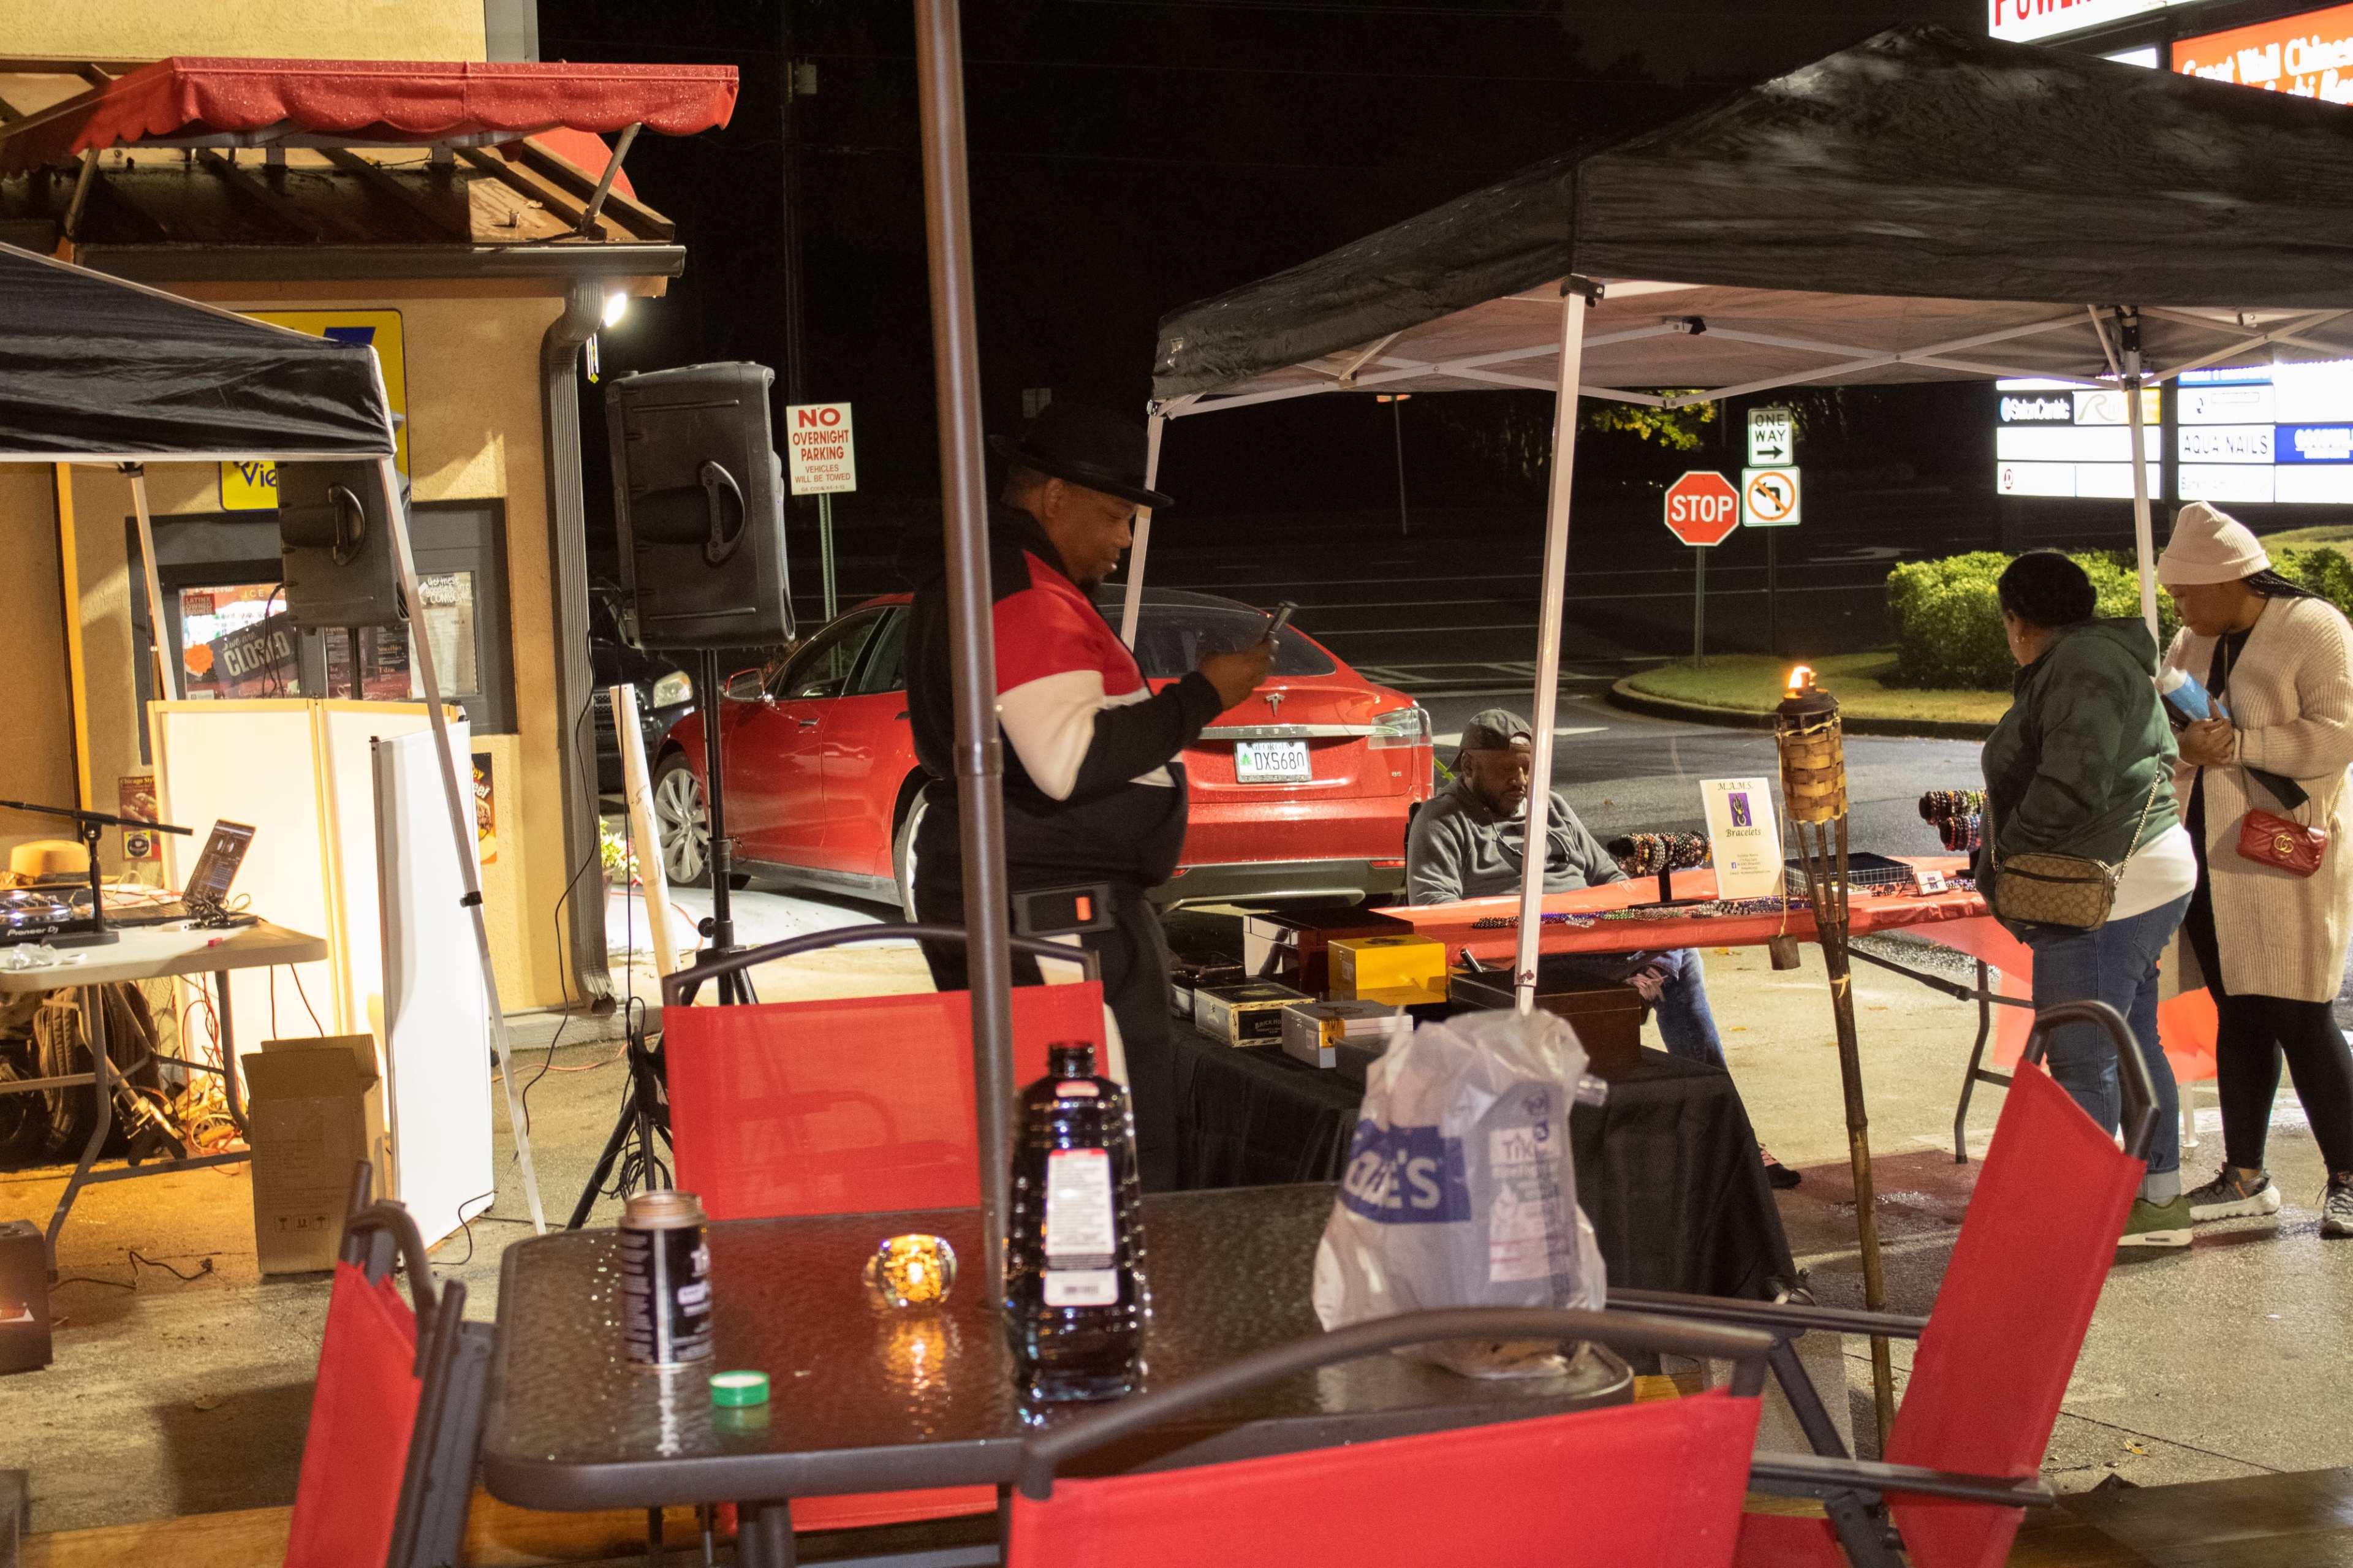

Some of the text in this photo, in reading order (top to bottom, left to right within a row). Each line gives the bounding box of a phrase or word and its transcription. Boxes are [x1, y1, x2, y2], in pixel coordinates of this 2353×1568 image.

[798, 407, 841, 428] NO
[1755, 414, 1785, 426] ONE
[793, 430, 849, 445] OVERNIGHT
[1755, 430, 1786, 442] WAY
[2184, 434, 2267, 454] AQUA NAILS
[801, 446, 844, 461] PARKING
[805, 464, 839, 473] VEHICLES
[826, 472, 851, 482] TOWED
[1671, 494, 1733, 522] STOP
[1725, 828, 1762, 838] Bracelets
[7, 928, 47, 937] Pioneer
